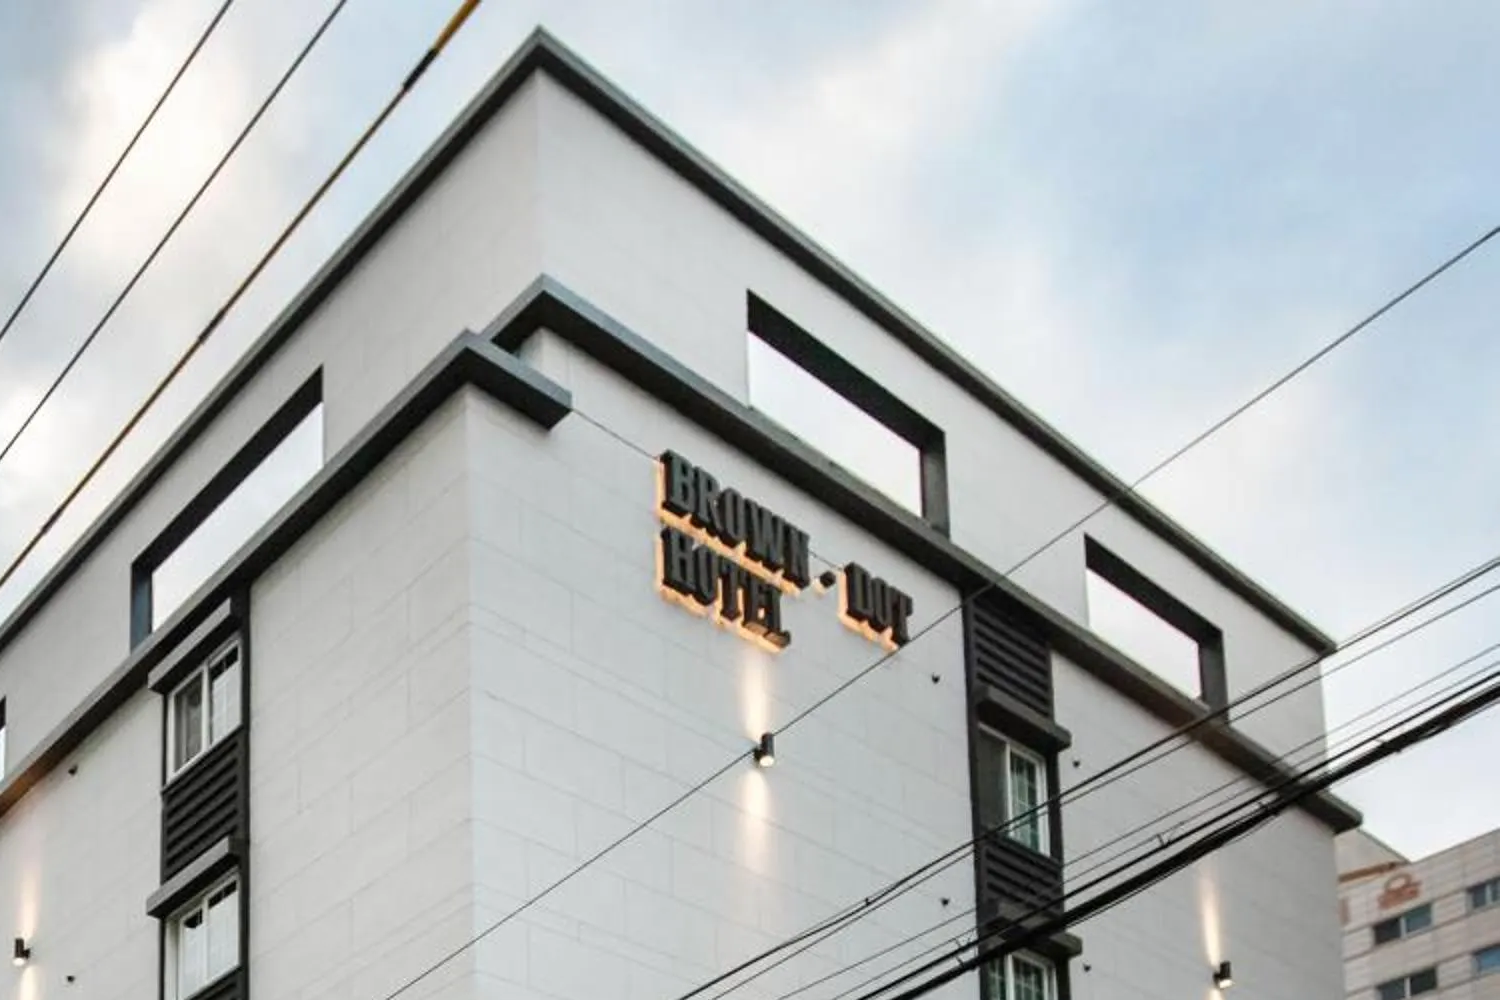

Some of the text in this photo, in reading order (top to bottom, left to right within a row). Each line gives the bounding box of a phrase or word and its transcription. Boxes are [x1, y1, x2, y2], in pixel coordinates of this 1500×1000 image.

[658, 449, 810, 592] BROWN
[841, 561, 913, 650] DOT
[658, 525, 791, 651] HOTEL
